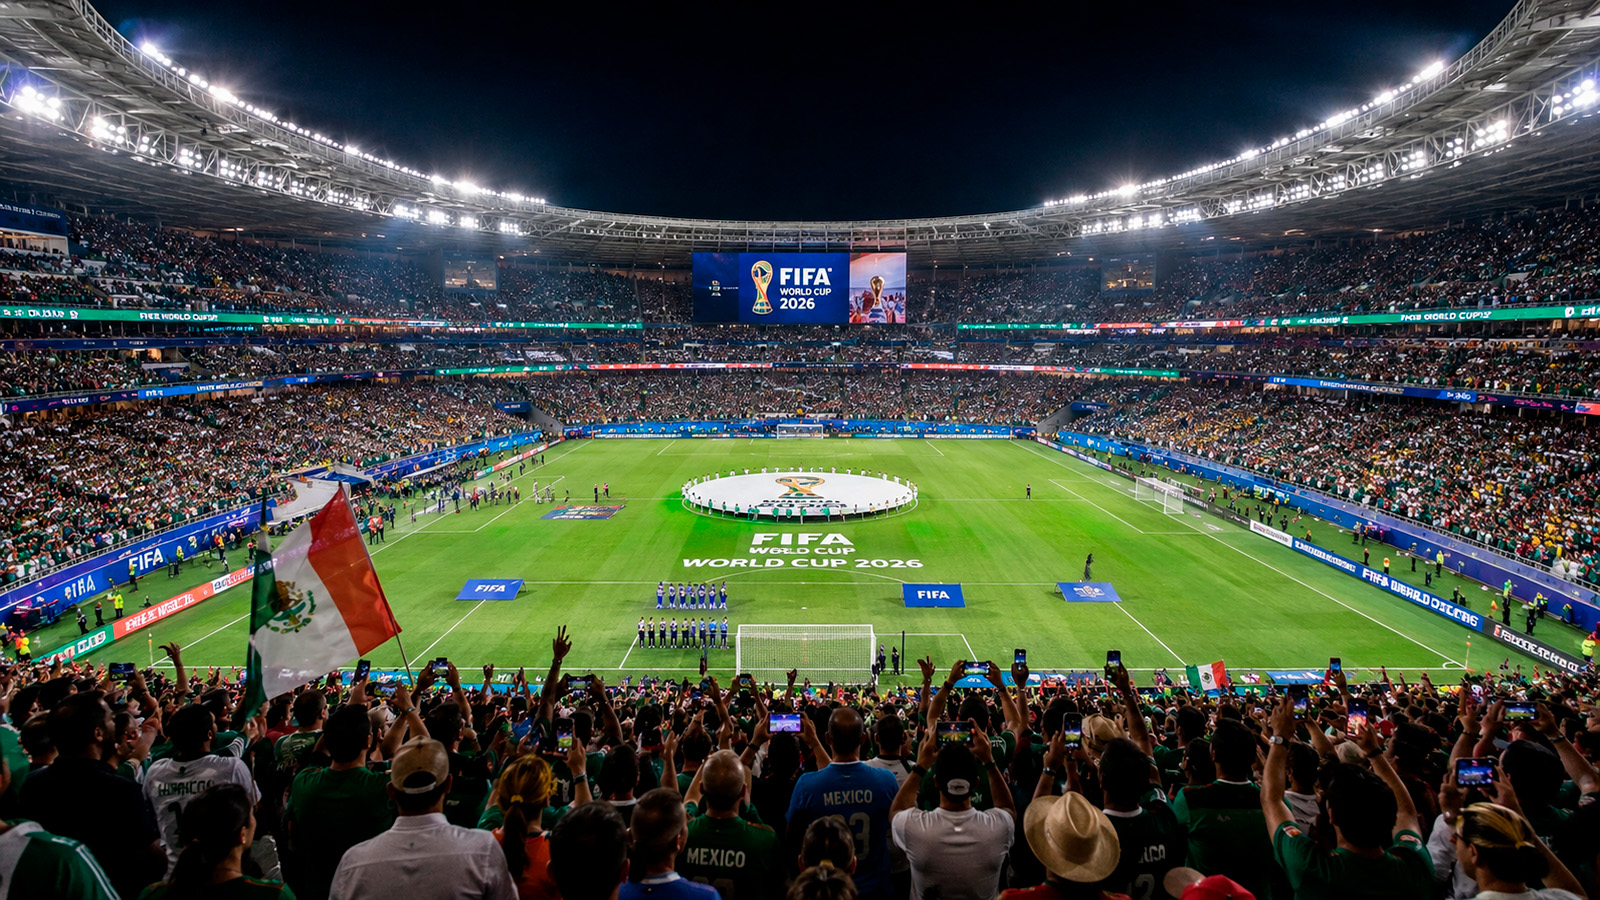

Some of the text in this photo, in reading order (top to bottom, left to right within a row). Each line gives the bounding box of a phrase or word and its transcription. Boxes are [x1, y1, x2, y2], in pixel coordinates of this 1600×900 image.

[780, 268, 831, 285] FIFA
[780, 288, 831, 296] WORLD CUP
[780, 298, 815, 309] 2026
[751, 533, 854, 545] FIFA
[749, 547, 856, 555] WORLD CUP
[129, 548, 164, 570] FIFA
[683, 558, 924, 568] WORLD CUP 2026
[474, 584, 506, 593] FIFA
[917, 590, 951, 600] FIFA
[823, 789, 873, 806] MEXICO
[686, 847, 746, 868] MEXICO
